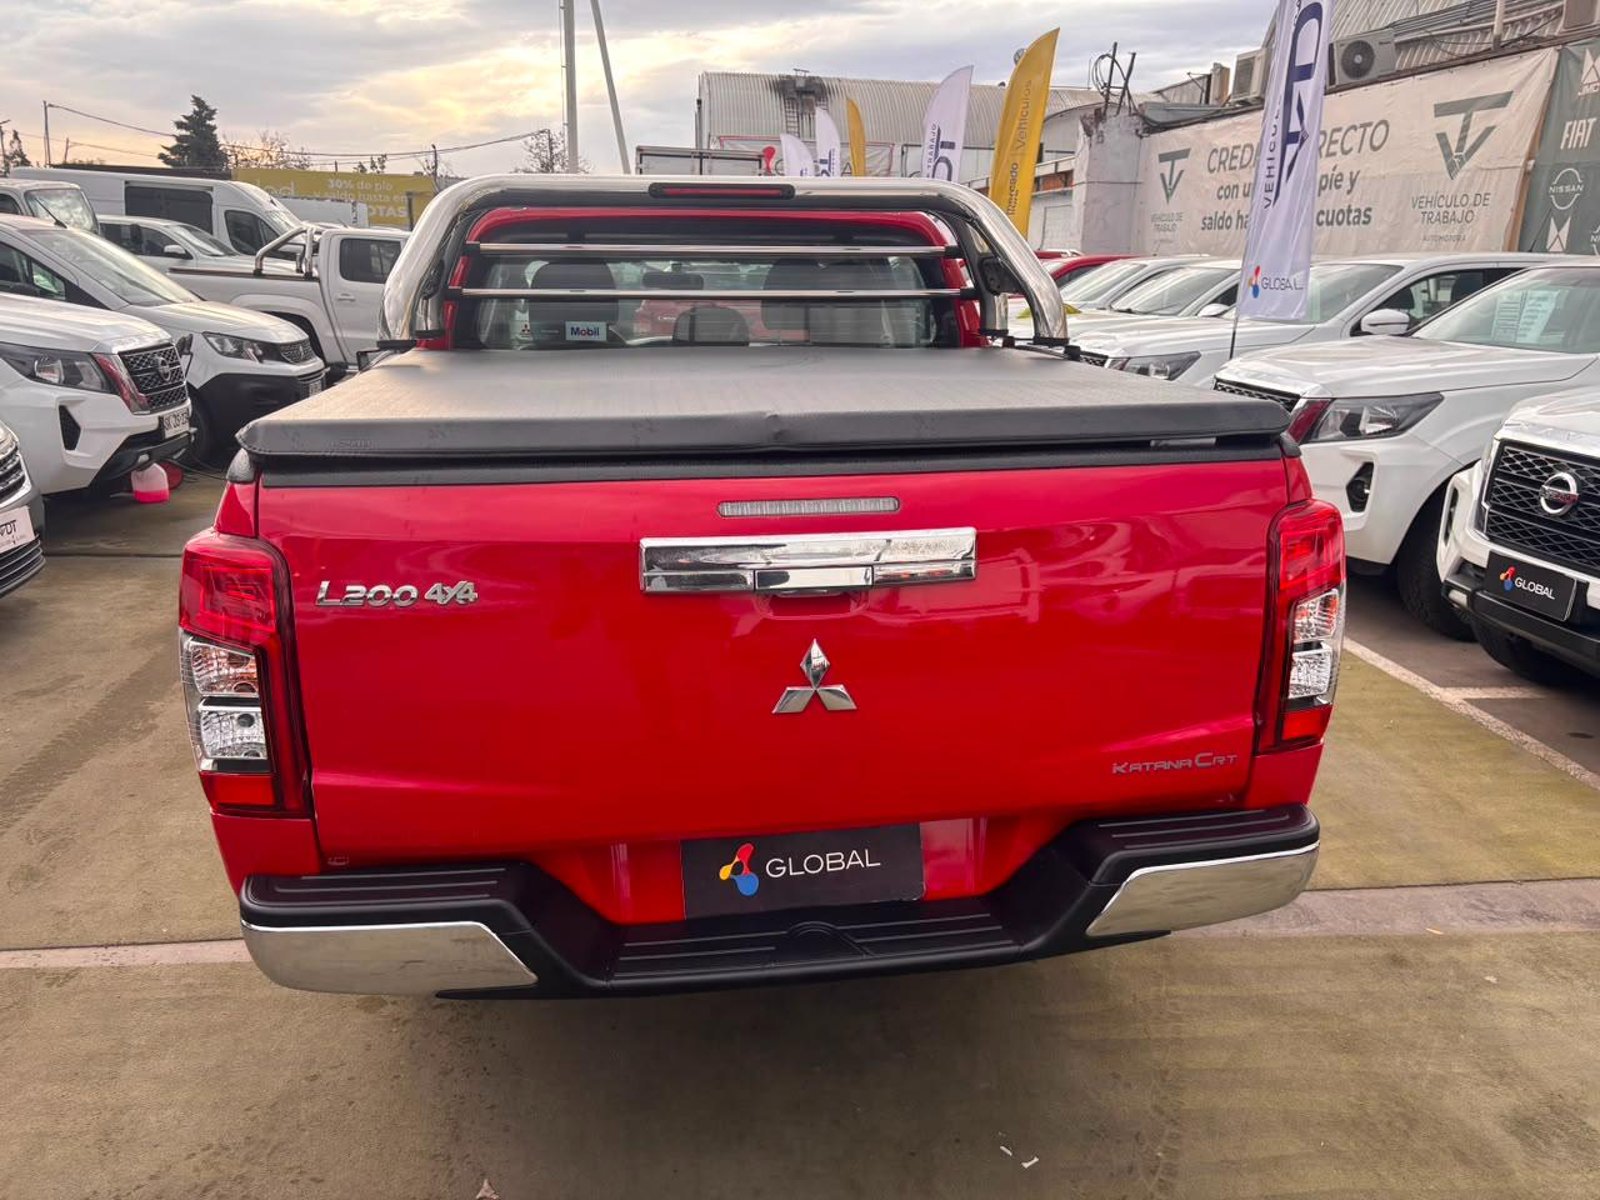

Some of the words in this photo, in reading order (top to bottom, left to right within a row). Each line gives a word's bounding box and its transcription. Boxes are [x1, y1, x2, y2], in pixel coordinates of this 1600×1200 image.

[1561, 117, 1597, 150] FIAT
[1217, 183, 1239, 200] con
[1243, 183, 1252, 198] u
[1346, 170, 1360, 195] y
[1549, 185, 1584, 193] NISSAN
[1473, 193, 1491, 207] DE
[1201, 211, 1232, 230] saldo
[1316, 204, 1372, 226] cuotas
[1421, 209, 1475, 225] TRABAJO
[1261, 276, 1304, 290] GLOBAL
[570, 326, 600, 336] Mobil
[316, 580, 418, 607] L200
[1514, 576, 1556, 601] GLOBAL
[765, 849, 881, 878] GLOBAL
